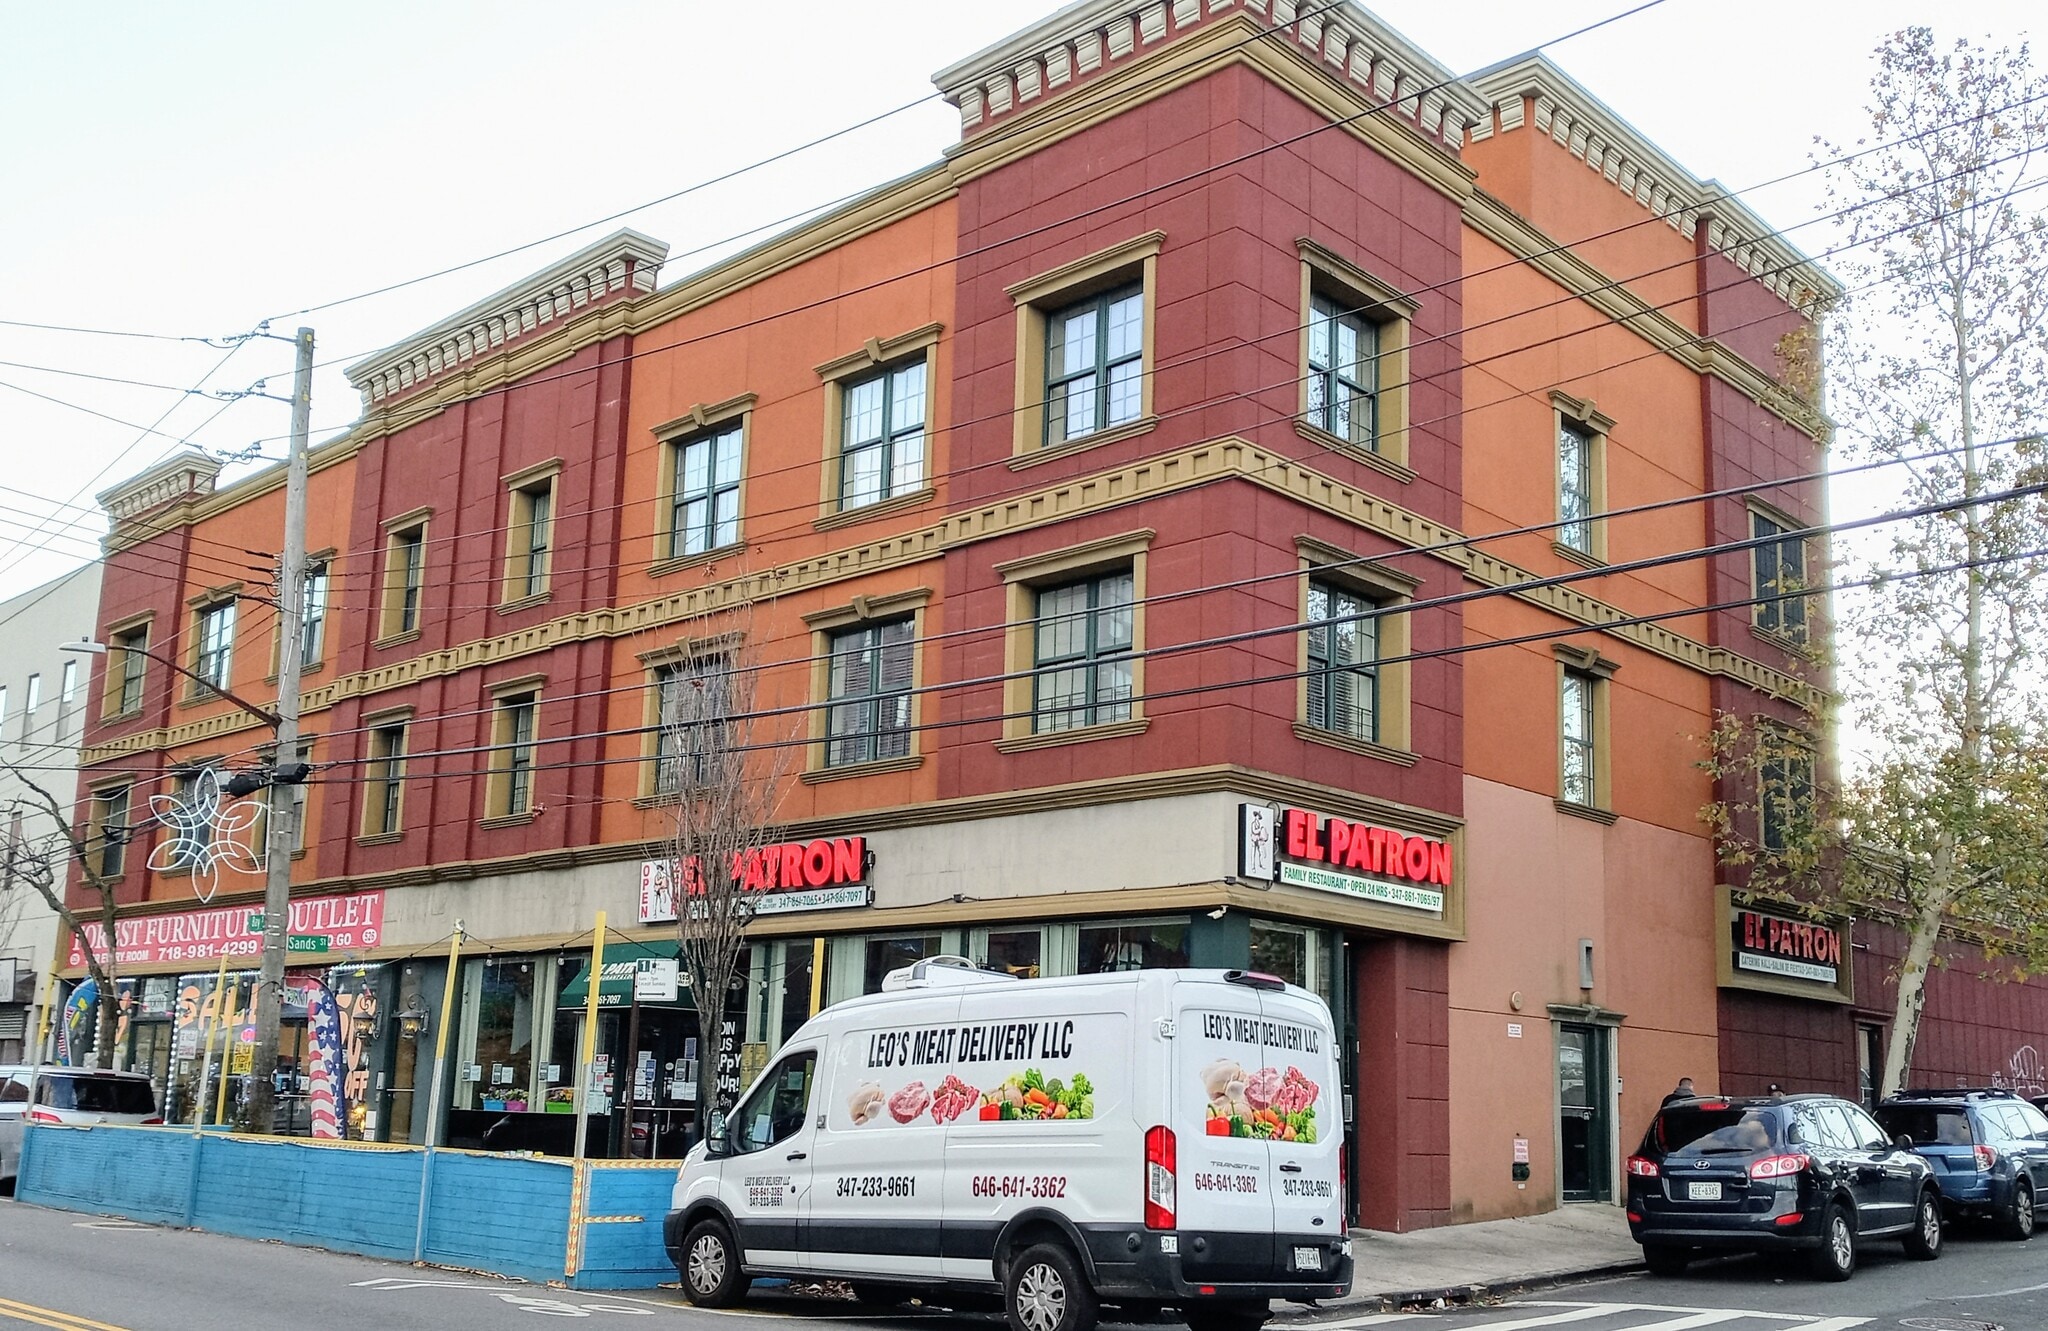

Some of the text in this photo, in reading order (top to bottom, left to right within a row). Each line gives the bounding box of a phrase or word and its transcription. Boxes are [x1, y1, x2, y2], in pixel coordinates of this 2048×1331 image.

[1287, 808, 1452, 886] EL PATRON
[641, 865, 650, 918] OPEN
[822, 890, 862, 905] 347-861-7097
[1284, 867, 1440, 907] FAMILY RESTAURANT OPEN 24 HRS 347-861-7065/97
[144, 906, 266, 945] FURNITUR
[288, 936, 316, 950] Sands
[336, 932, 351, 946] GO
[1744, 912, 1841, 965] EL PATRON
[126, 950, 149, 962] ROOM
[157, 939, 258, 961] 718-981-4299
[868, 1020, 1074, 1068] LEO'S MEAT DELIVERY LLC
[1203, 1013, 1319, 1054] LEO'S MEAT DELIVERY LLC
[1210, 1160, 1249, 1170] TRANSIT
[765, 1176, 783, 1186] DELIVERY
[836, 1175, 1067, 1199] 347-233-9661 646-641-3362
[1195, 1173, 1258, 1193] 646-641-3362
[1282, 1179, 1333, 1198] 347-233-9661
[749, 1187, 783, 1197] 646-641-3362
[749, 1197, 783, 1207] 347-233-9661
